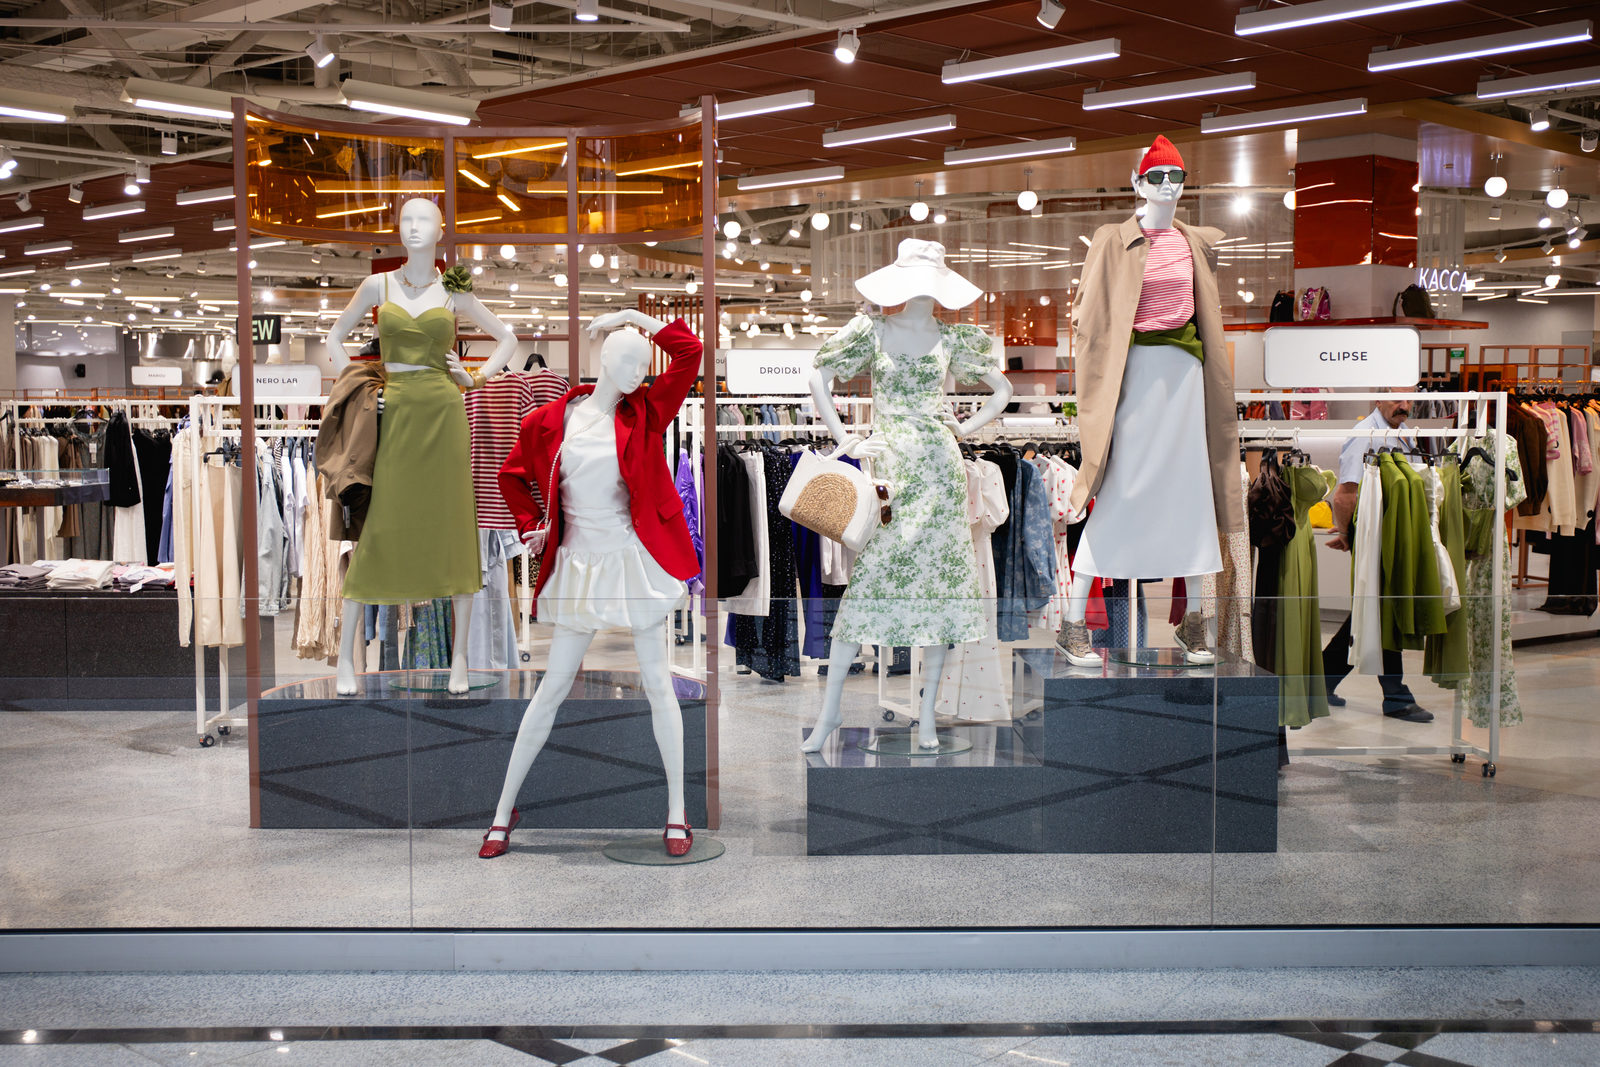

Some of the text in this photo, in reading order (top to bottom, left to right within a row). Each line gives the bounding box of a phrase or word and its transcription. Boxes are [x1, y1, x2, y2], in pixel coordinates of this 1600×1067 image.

[252, 319, 275, 341] EW
[1319, 351, 1368, 362] CLIPSE
[760, 366, 801, 375] DROID&I
